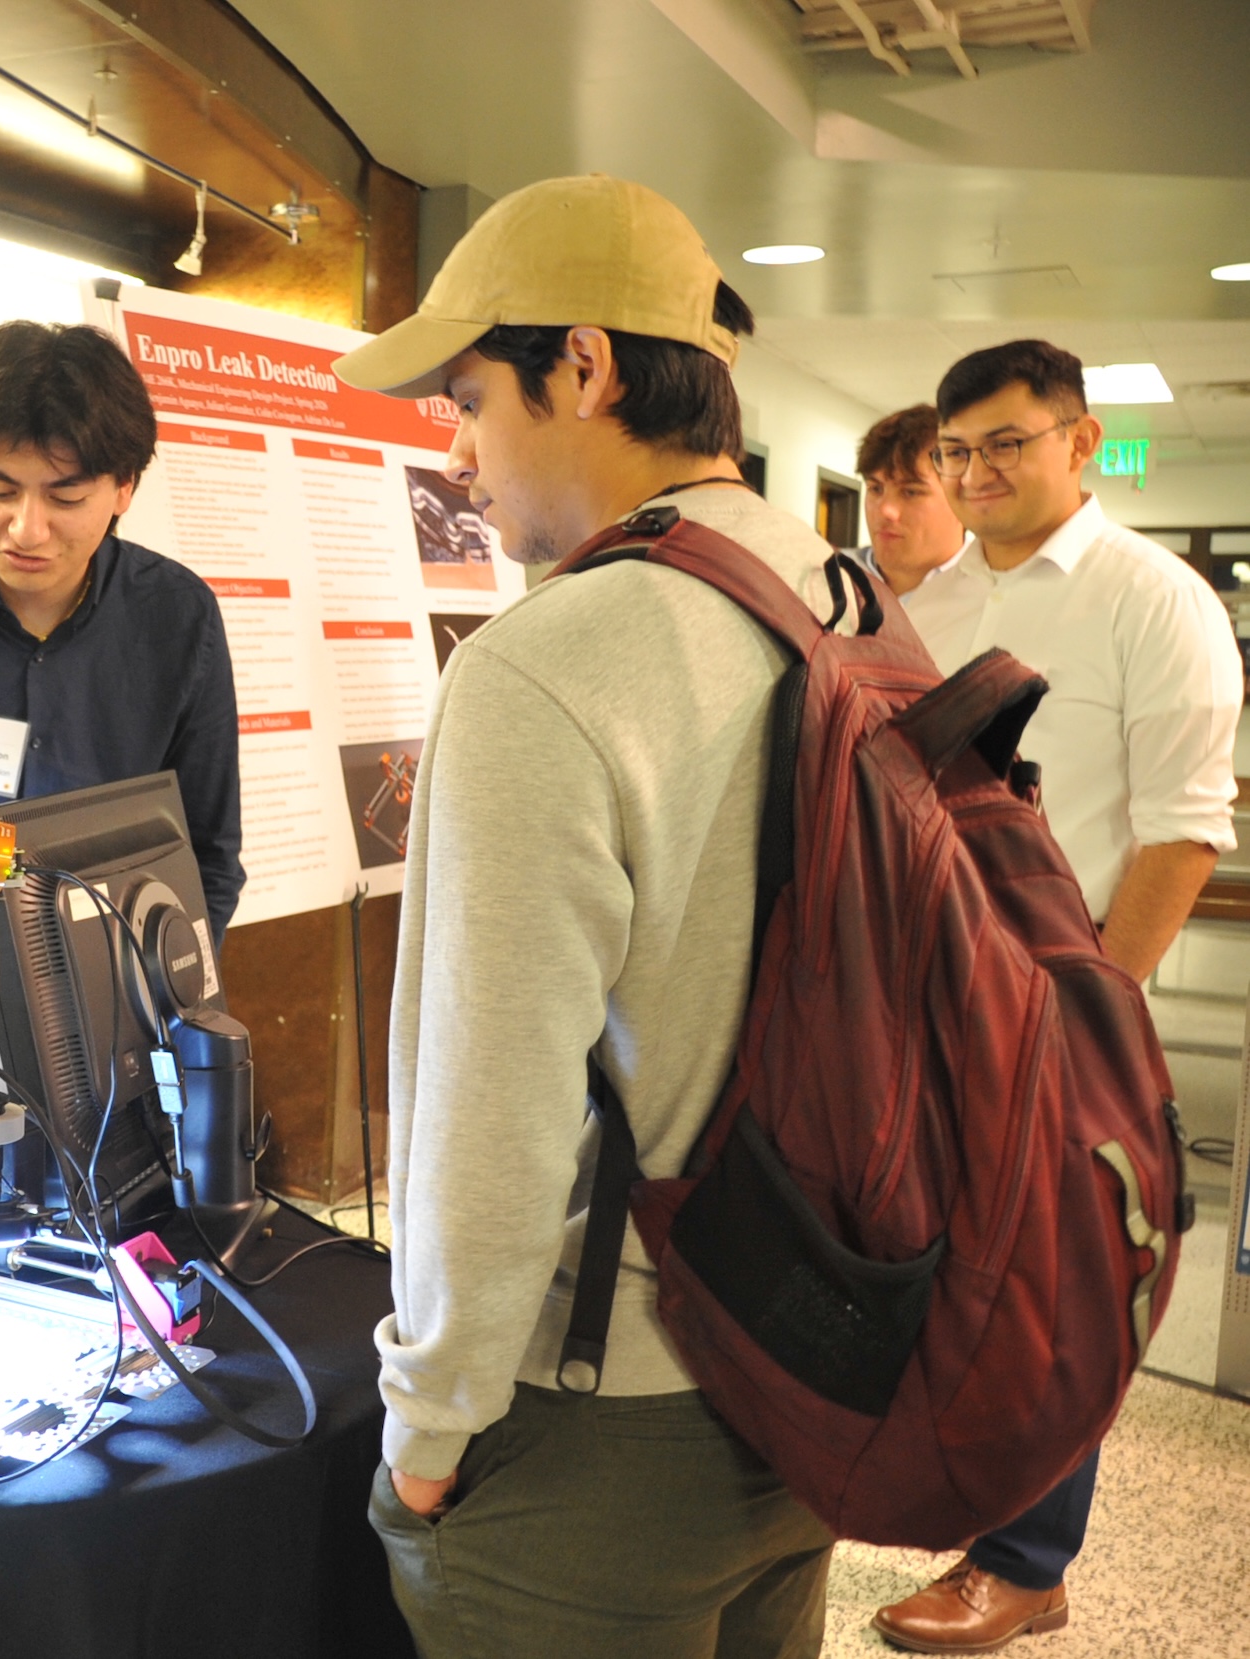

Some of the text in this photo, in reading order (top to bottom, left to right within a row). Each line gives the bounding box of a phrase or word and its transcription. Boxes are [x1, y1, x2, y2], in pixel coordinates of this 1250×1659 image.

[135, 333, 338, 393] Enpro Leak Detection
[1100, 438, 1150, 476] EXIT
[172, 951, 198, 972] SAMSUNG
